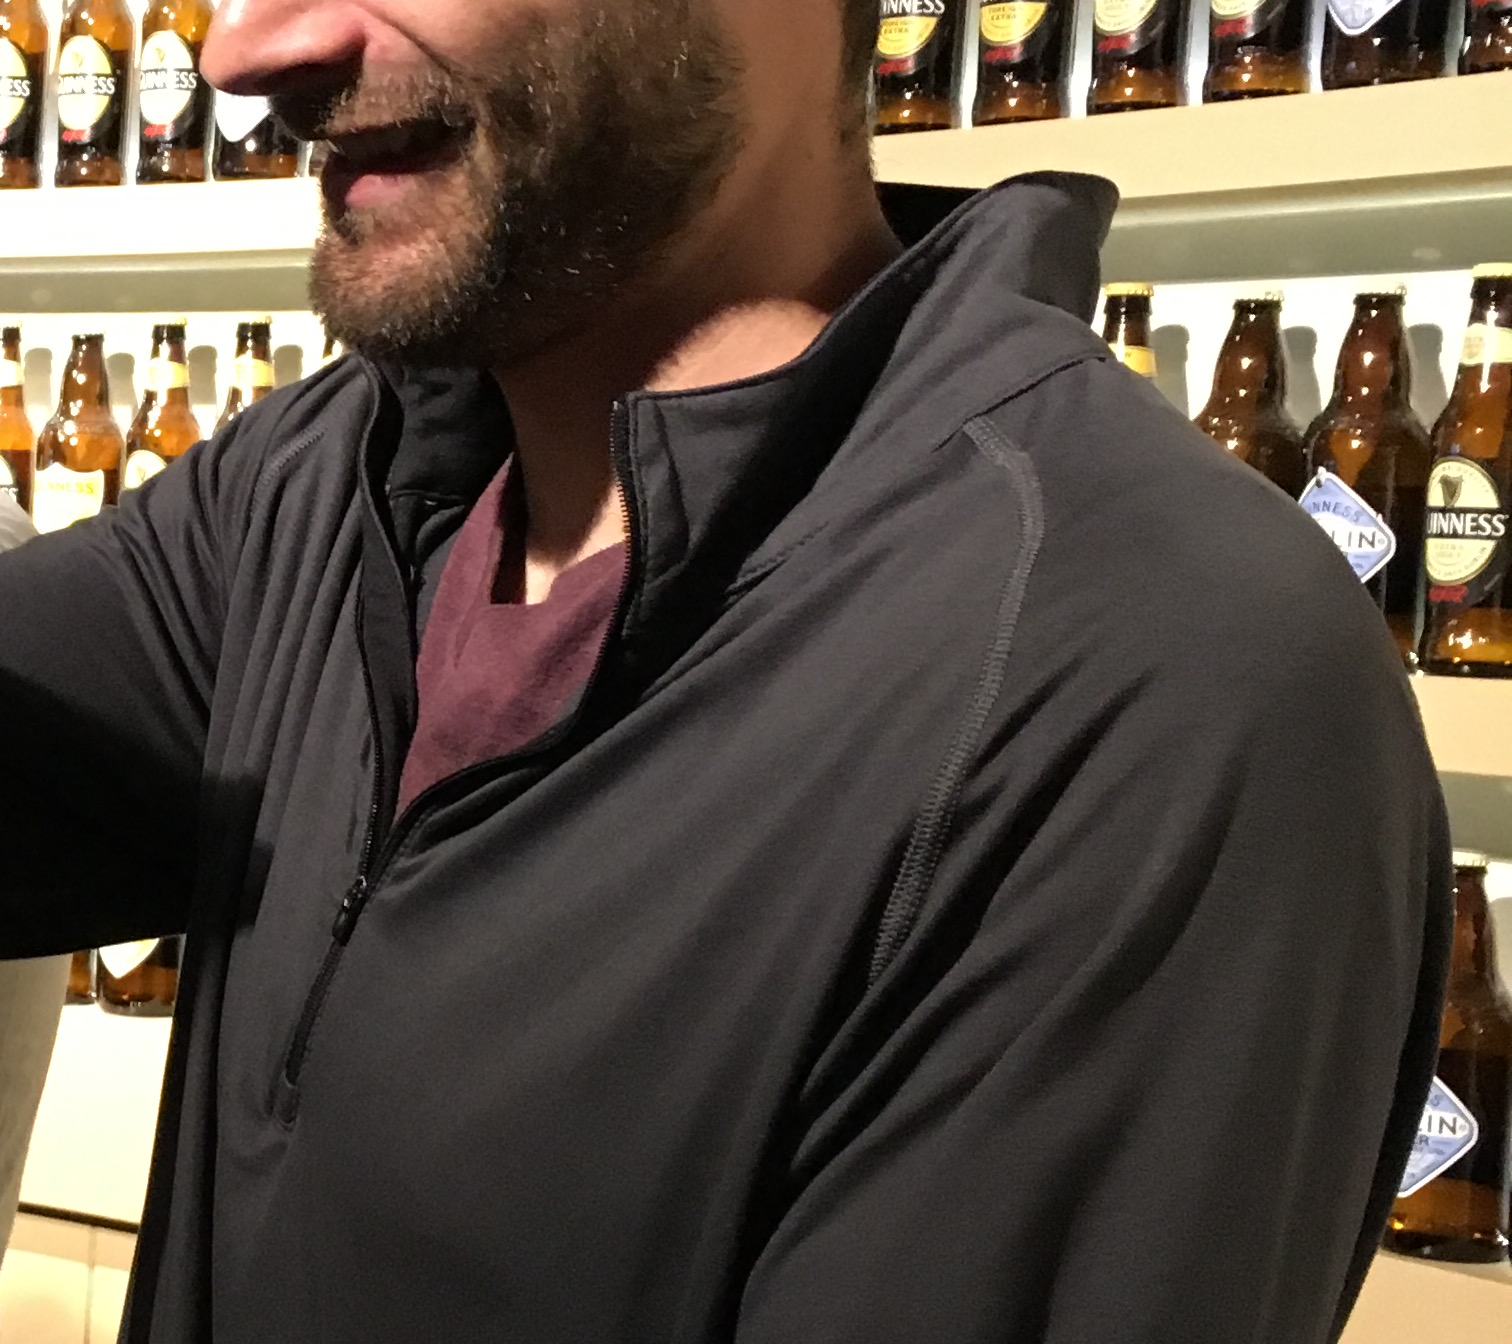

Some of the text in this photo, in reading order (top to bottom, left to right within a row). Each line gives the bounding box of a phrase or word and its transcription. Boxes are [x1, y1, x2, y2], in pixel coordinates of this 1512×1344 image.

[1311, 500, 1361, 523] NNESS
[1428, 512, 1506, 536] UINNESS
[1331, 529, 1377, 550] LIN
